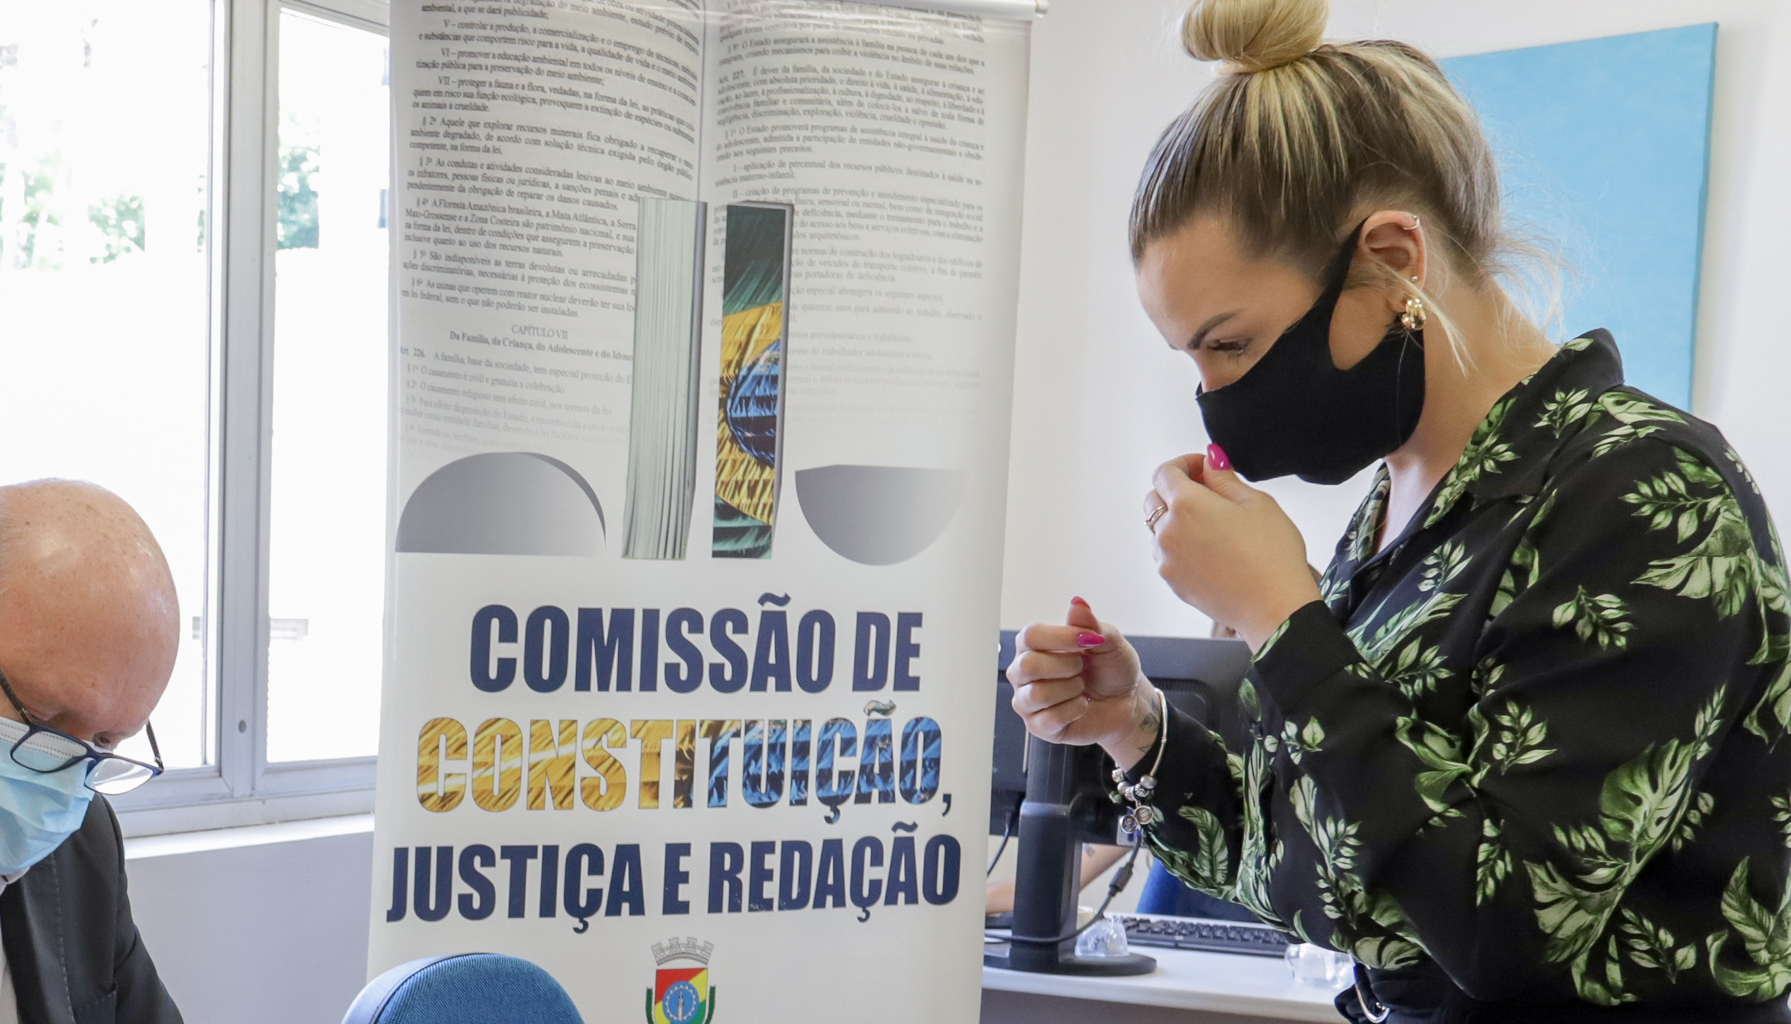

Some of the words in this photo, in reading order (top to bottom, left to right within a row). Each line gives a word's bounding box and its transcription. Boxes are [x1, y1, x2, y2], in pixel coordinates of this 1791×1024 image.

[450, 330, 461, 341] Da
[461, 331, 491, 345] Família,
[491, 335, 501, 345] da
[502, 337, 535, 351] Criança,
[535, 341, 546, 351] do
[547, 343, 594, 358] Adolescente
[595, 350, 600, 358] e
[600, 349, 611, 360] do
[612, 350, 633, 361] Idoso
[511, 323, 555, 338] CAPÍTULO
[555, 329, 568, 340] VII
[470, 592, 837, 694] COMISSÃO
[852, 611, 924, 692] DE
[416, 700, 952, 824] CONSTITUIÇÃO,
[387, 842, 645, 934] JUSTIÇA
[662, 842, 692, 916] E
[708, 821, 962, 922] REDAÇÃO
